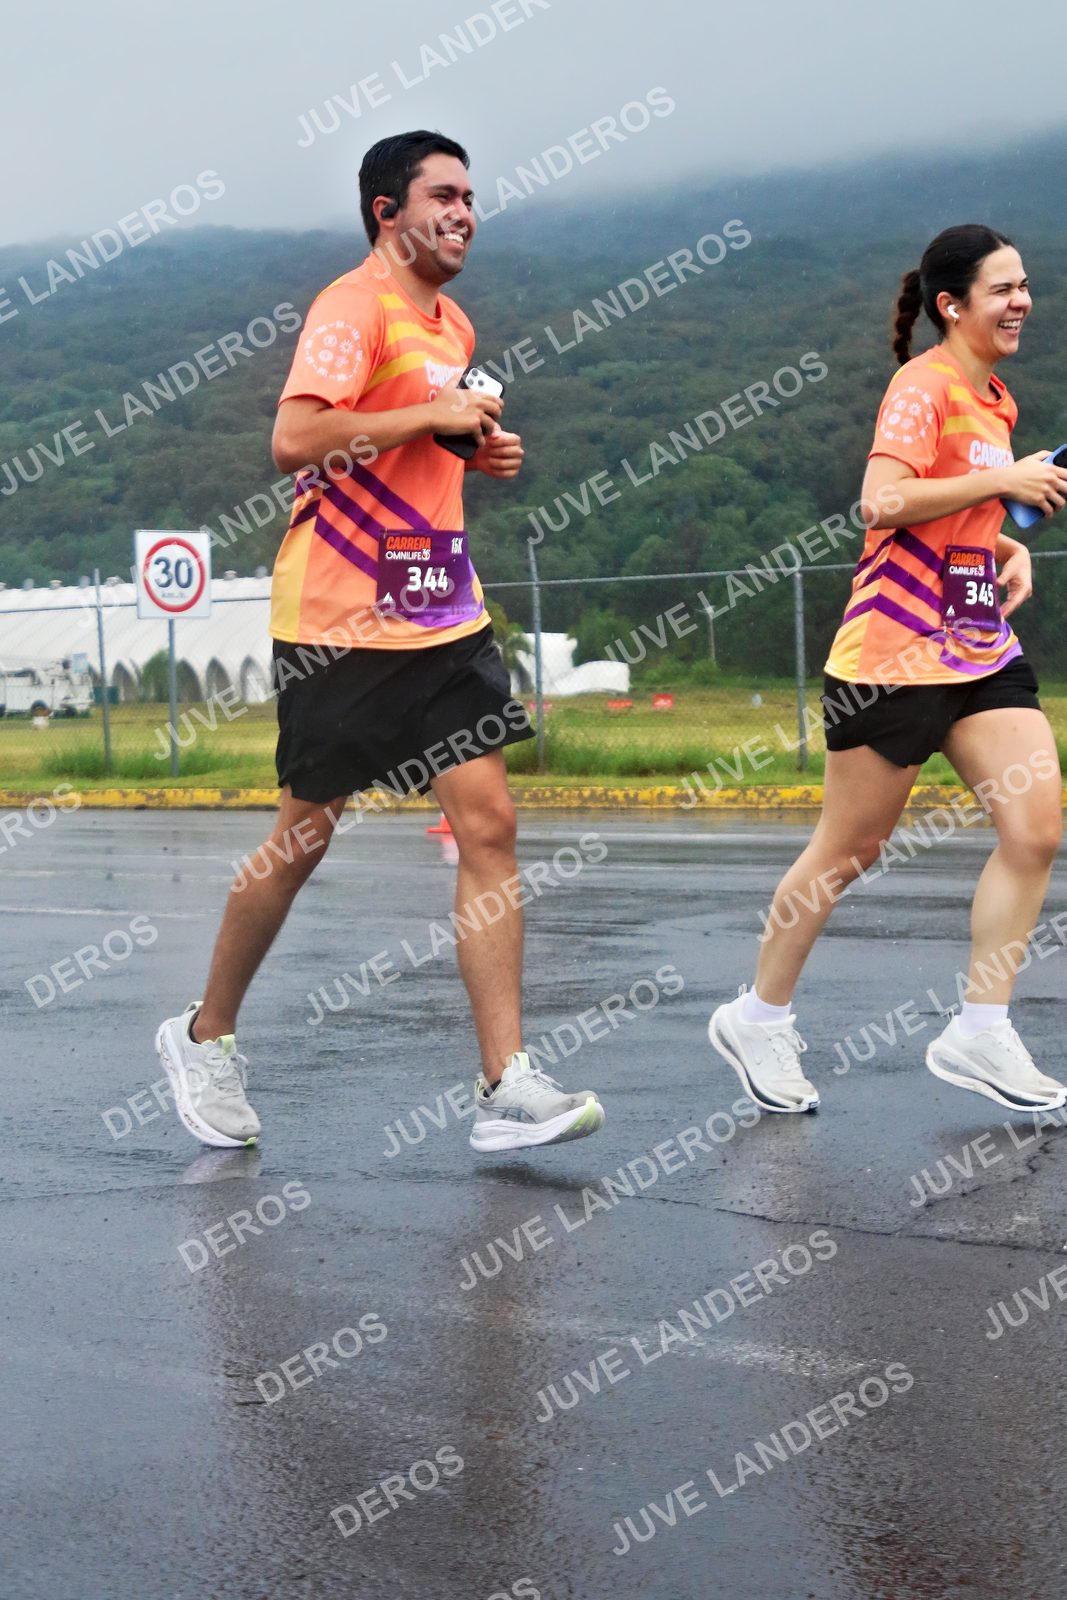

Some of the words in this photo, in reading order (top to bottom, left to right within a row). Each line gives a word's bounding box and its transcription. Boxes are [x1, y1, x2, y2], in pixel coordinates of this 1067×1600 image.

[385, 550, 422, 560] OMNILIFE
[386, 536, 432, 550] CARRERA
[154, 557, 193, 589] 30
[406, 566, 448, 591] 344
[965, 581, 994, 607] 345
